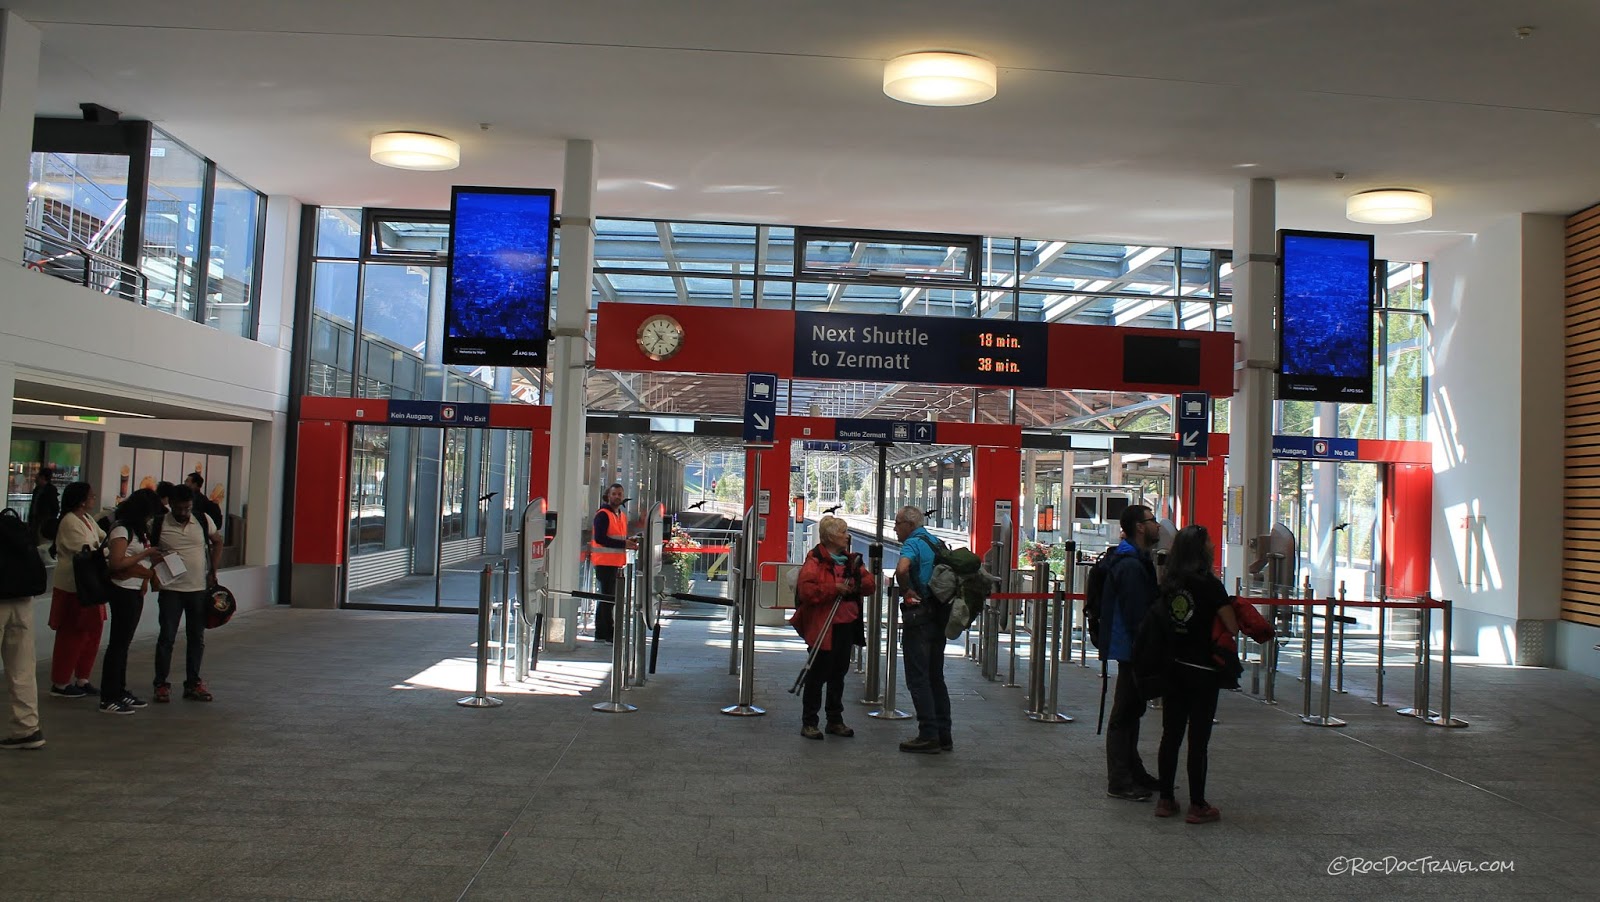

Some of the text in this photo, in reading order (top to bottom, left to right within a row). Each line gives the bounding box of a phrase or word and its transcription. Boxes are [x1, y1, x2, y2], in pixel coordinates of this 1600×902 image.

[812, 325, 929, 346] Next Shuttle
[979, 333, 1021, 348] 18 min.
[811, 350, 910, 370] to Zermatt
[978, 357, 1020, 373] 38 min.
[406, 412, 434, 421] Ausgang
[840, 430, 887, 439] Shuttle Zermatt
[1282, 447, 1307, 456] Ausgang
